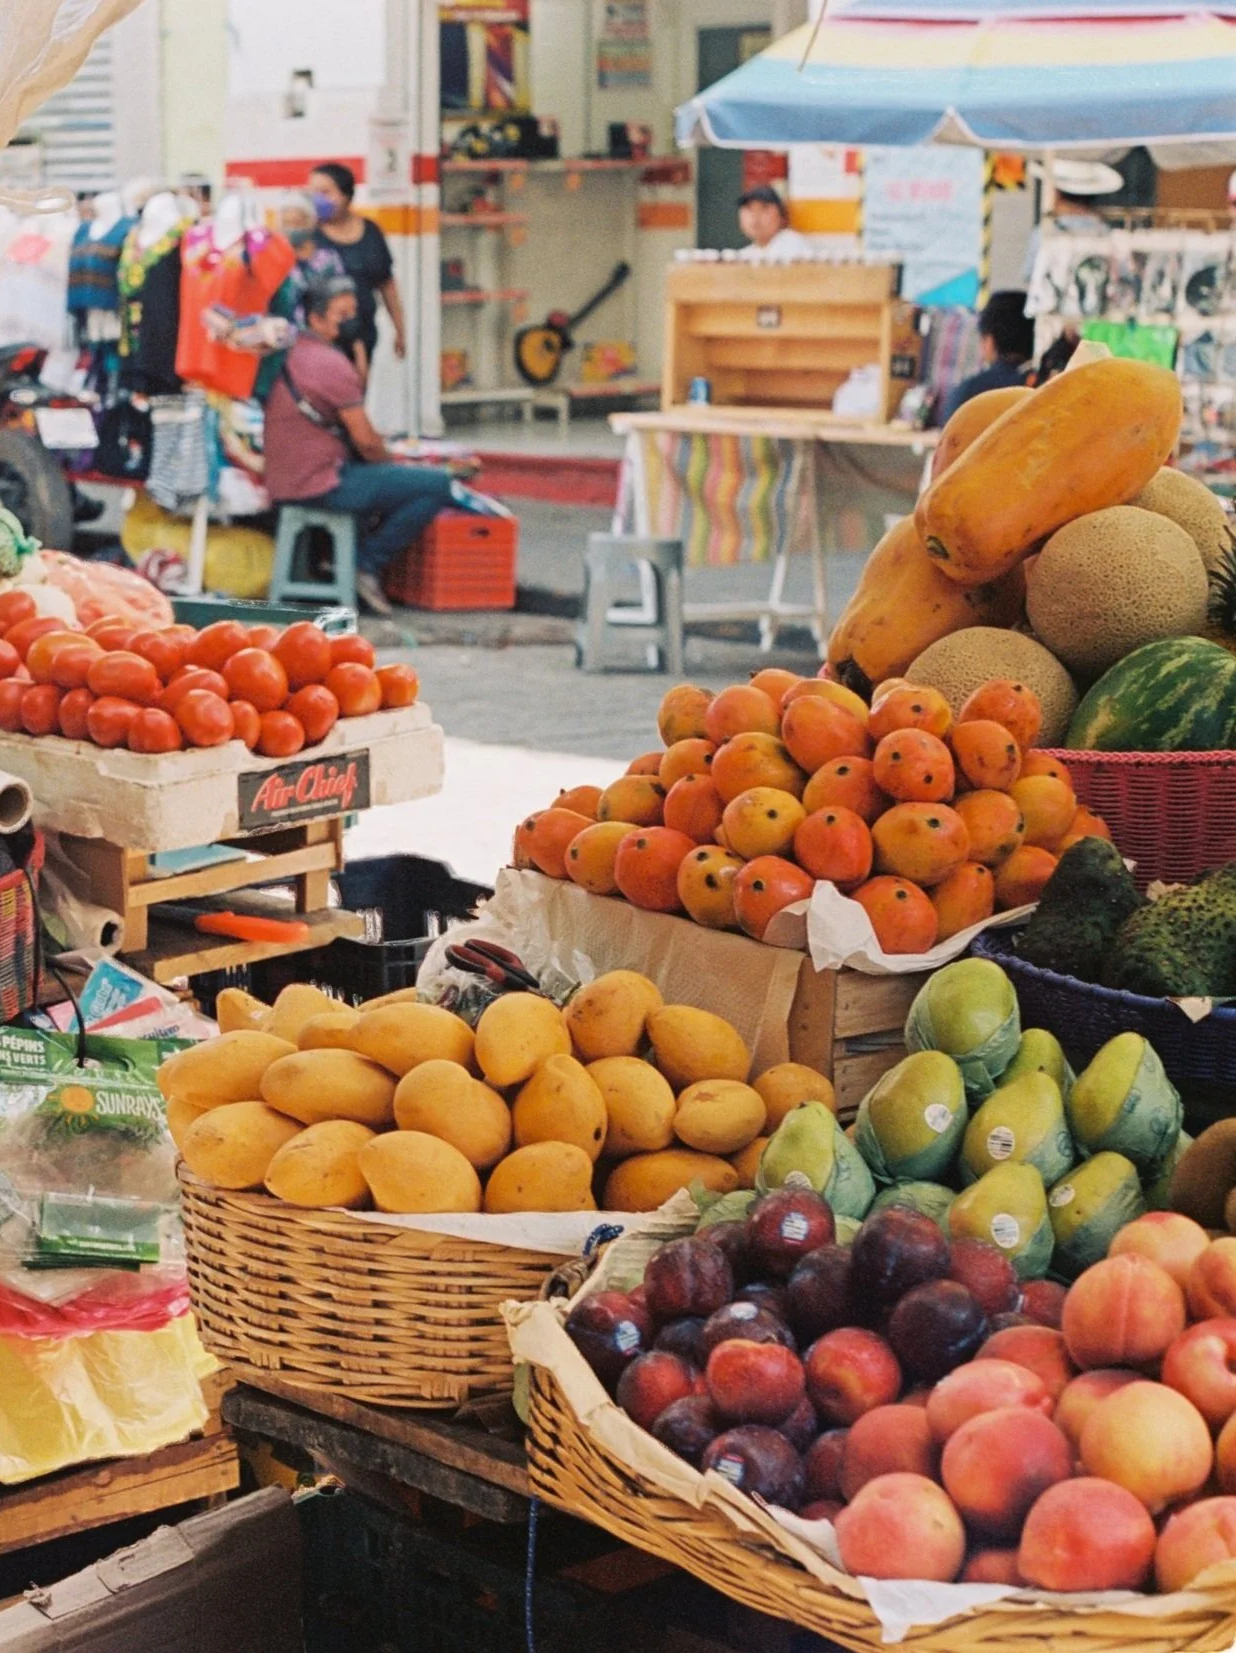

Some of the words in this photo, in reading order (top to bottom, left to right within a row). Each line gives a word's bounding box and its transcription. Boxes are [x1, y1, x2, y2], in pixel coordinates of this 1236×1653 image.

[251, 772, 295, 813] Air
[295, 762, 358, 809] Chief
[1, 1033, 45, 1053] PÉPINS
[12, 1051, 46, 1066] VERTS
[95, 1090, 162, 1121] SUNRAYS
